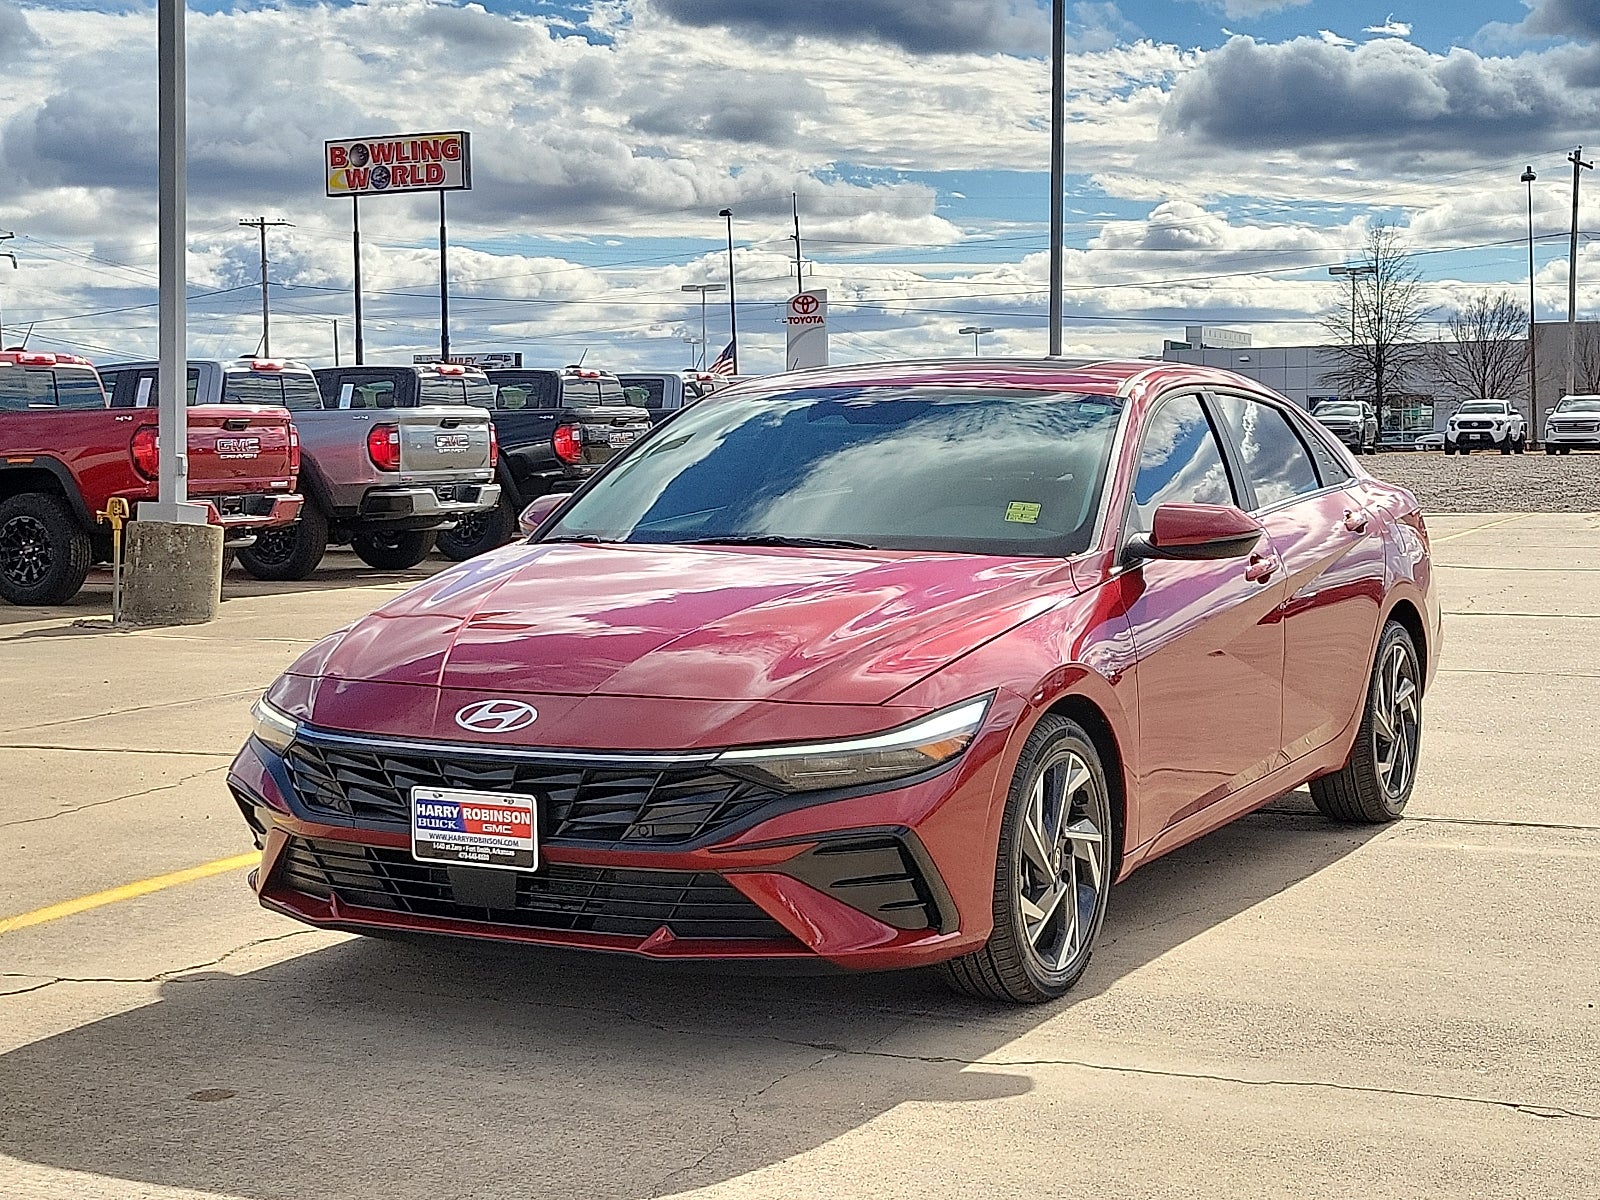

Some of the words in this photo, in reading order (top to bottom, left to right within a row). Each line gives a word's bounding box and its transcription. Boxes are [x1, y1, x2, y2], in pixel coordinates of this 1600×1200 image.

[329, 138, 461, 169] BOWLING
[344, 163, 447, 190] WORLD
[787, 315, 825, 325] TOYOTA
[216, 437, 260, 452] GMC
[436, 434, 469, 447] GMC
[416, 803, 460, 818] HARRY
[463, 807, 531, 825] ROBINSON
[417, 817, 457, 829] BUICK
[482, 824, 512, 834] GMC
[428, 832, 520, 847] WWW.HARRYROBINSON.COM
